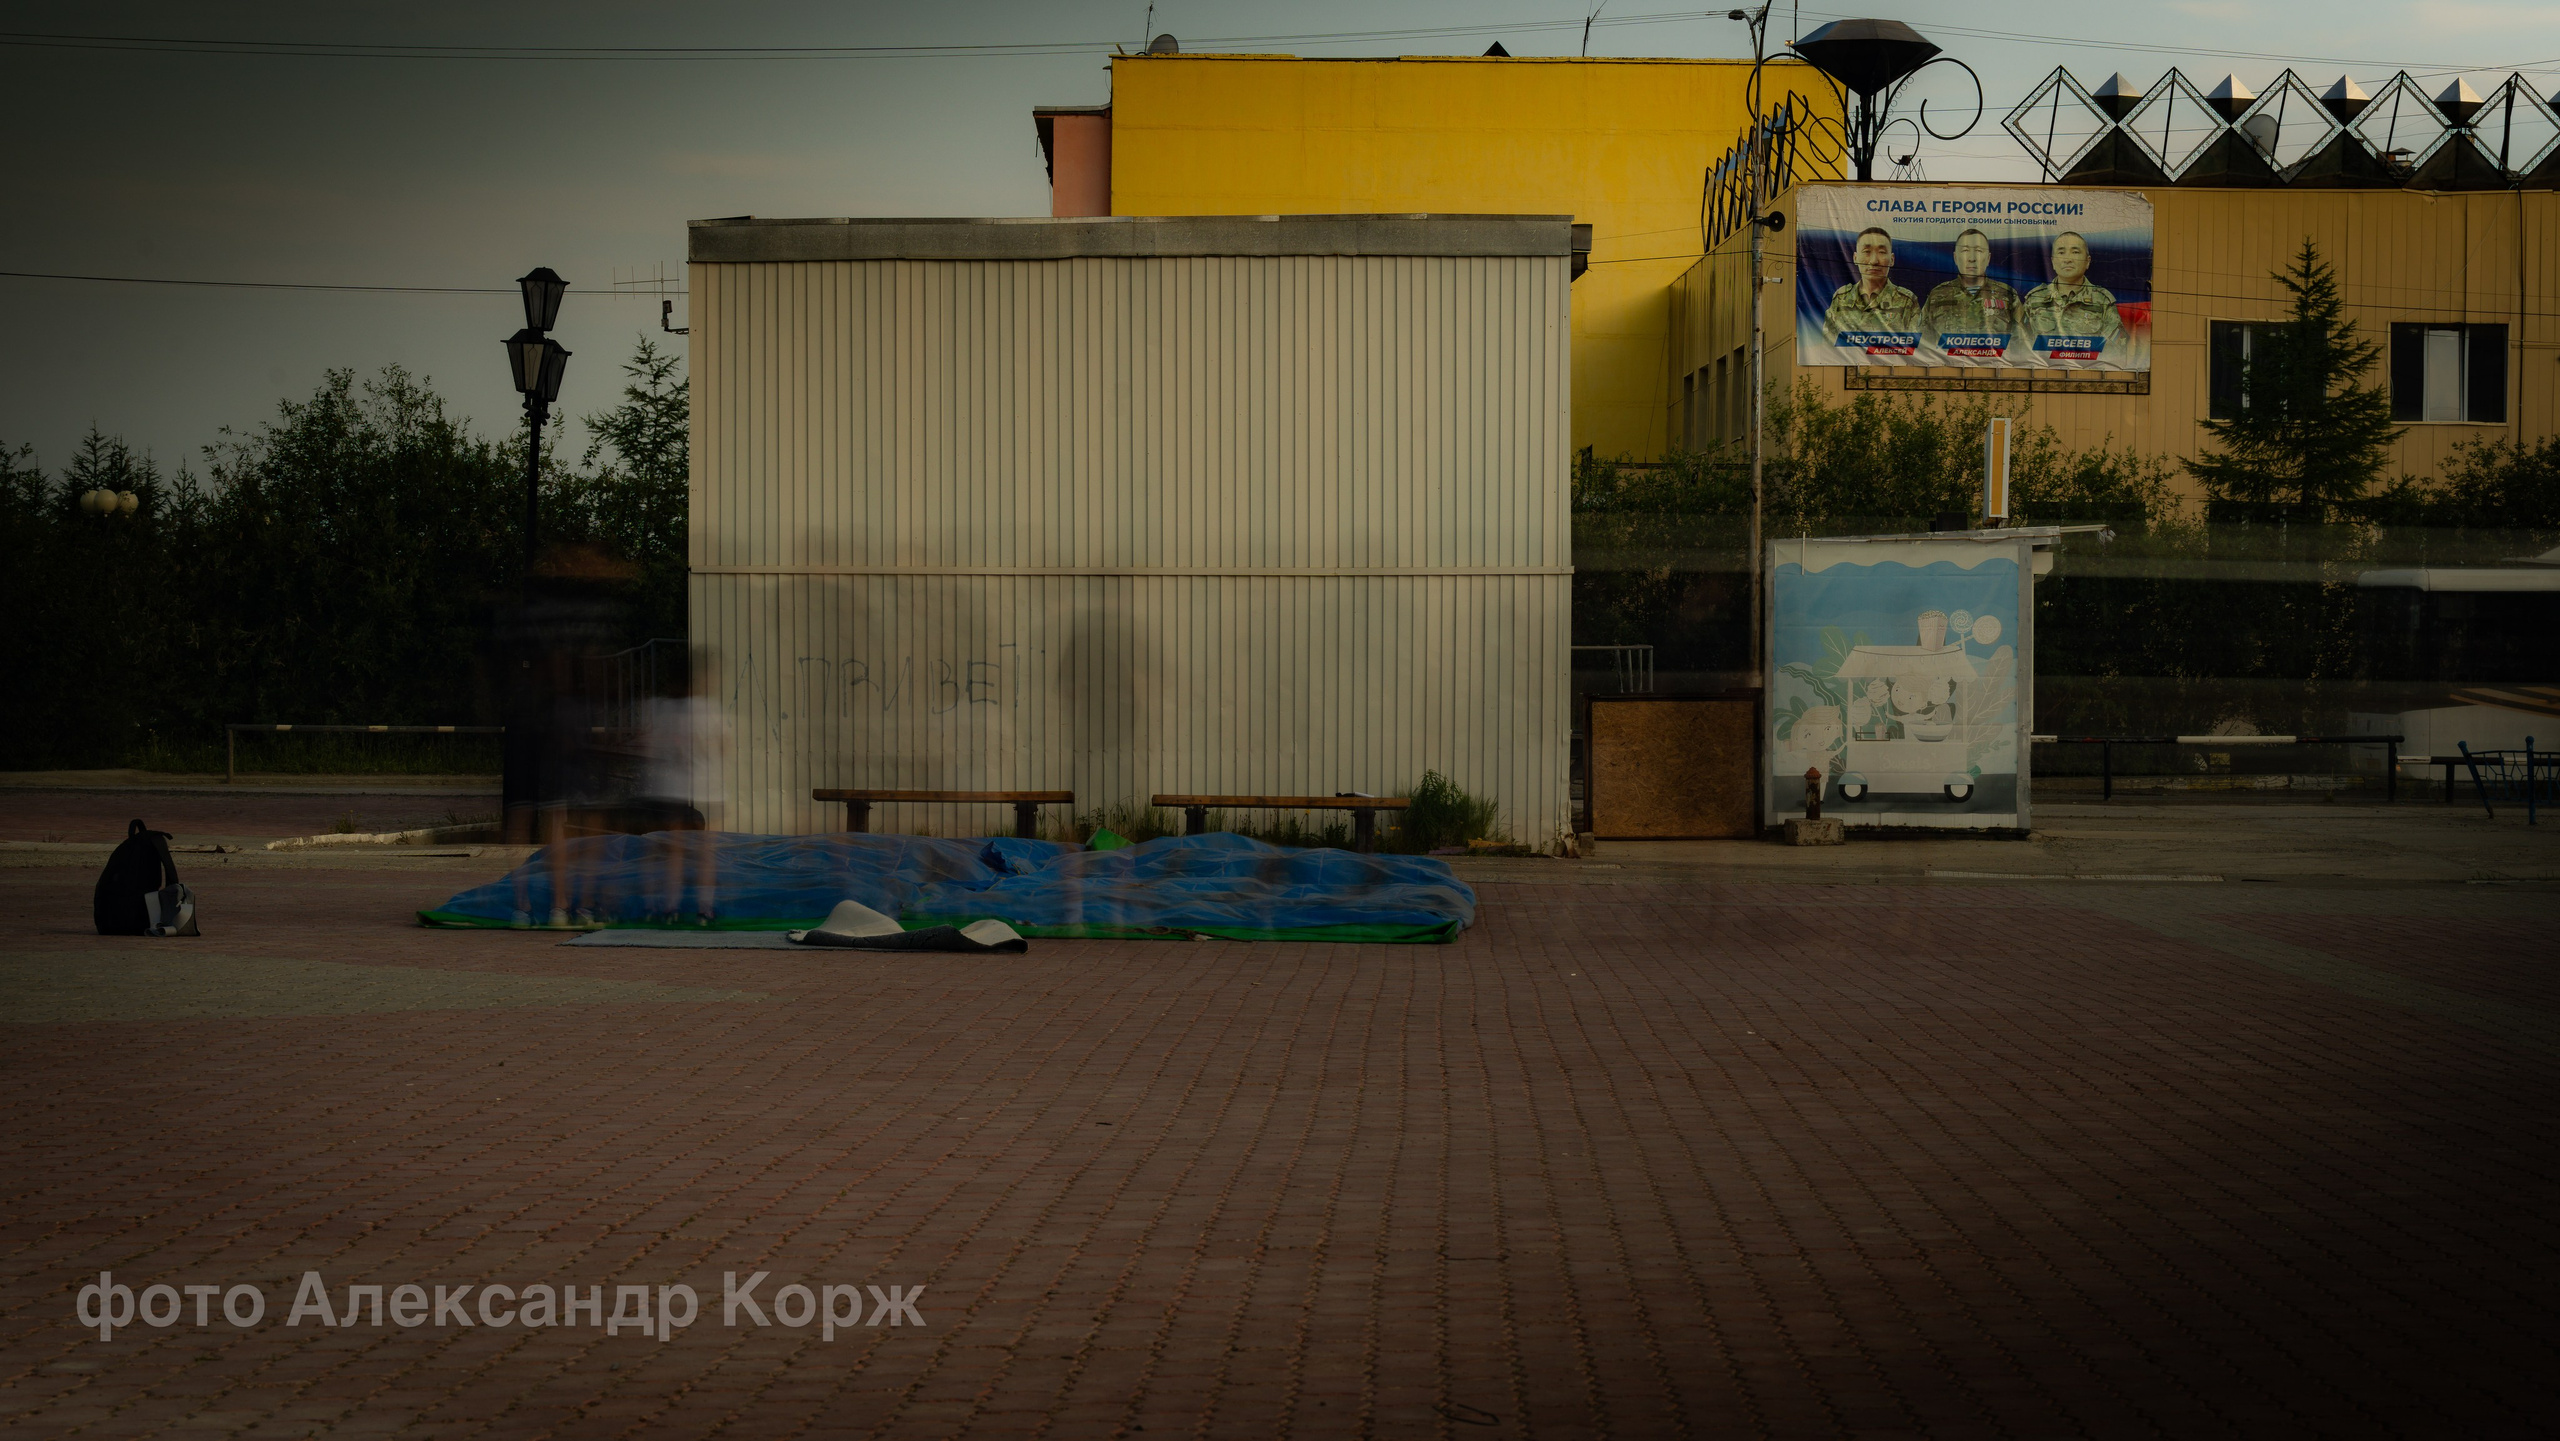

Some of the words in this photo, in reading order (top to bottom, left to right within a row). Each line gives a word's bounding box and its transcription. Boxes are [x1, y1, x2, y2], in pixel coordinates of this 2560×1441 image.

[1866, 199, 1927, 212] СЛАВА
[1932, 200, 2002, 213] ГЕРОЯМ
[2007, 202, 2084, 216] РОССИИ!
[1846, 334, 1915, 345] НЕУСТРОЕВ
[1946, 336, 2002, 347] КОЛЕСОВ
[2047, 339, 2092, 348] ЕВСЕЕВ
[2058, 351, 2091, 359] ФИЛИПП
